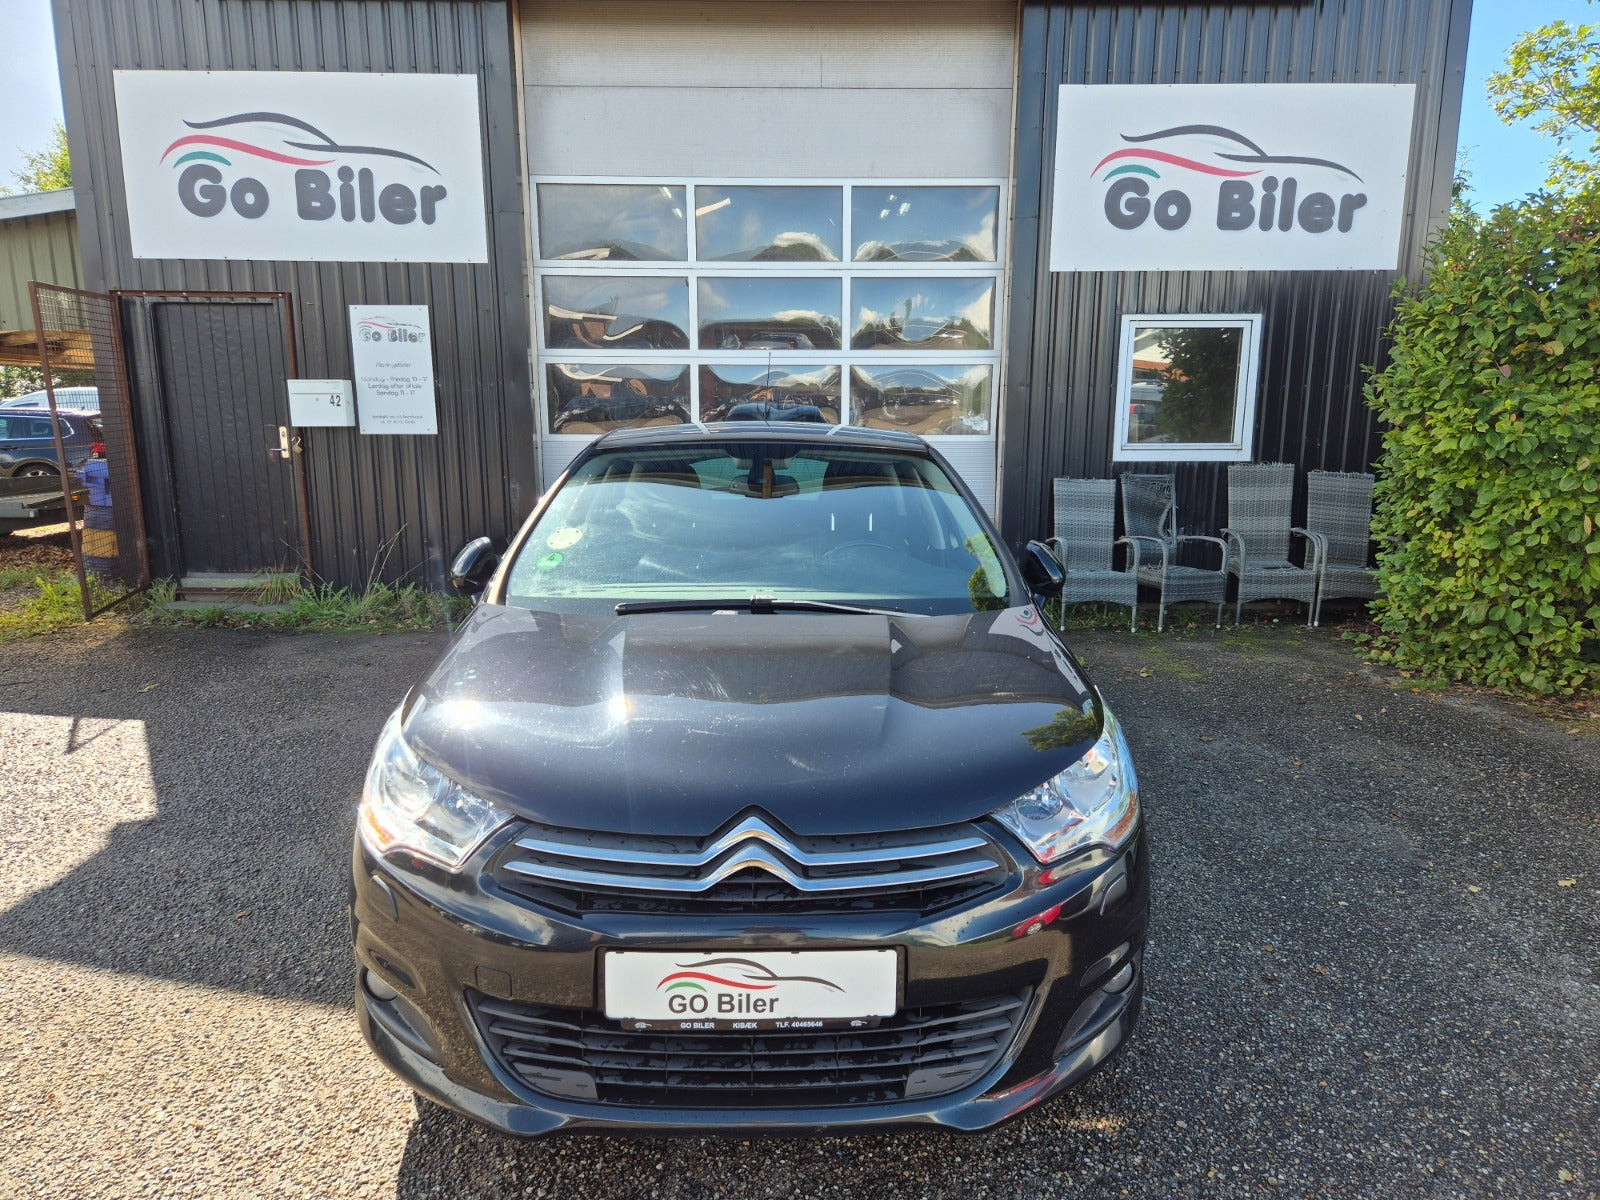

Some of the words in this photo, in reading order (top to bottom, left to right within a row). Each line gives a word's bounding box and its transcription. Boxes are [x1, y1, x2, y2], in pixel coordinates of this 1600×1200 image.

[178, 163, 269, 219] Go
[294, 165, 447, 225] Biler
[1104, 176, 1191, 231] Go
[1216, 175, 1368, 234] Biler
[359, 328, 382, 342] Go
[387, 328, 426, 343] Biler
[330, 395, 341, 407] 42
[668, 994, 709, 1014] GO
[717, 993, 780, 1014] Biler
